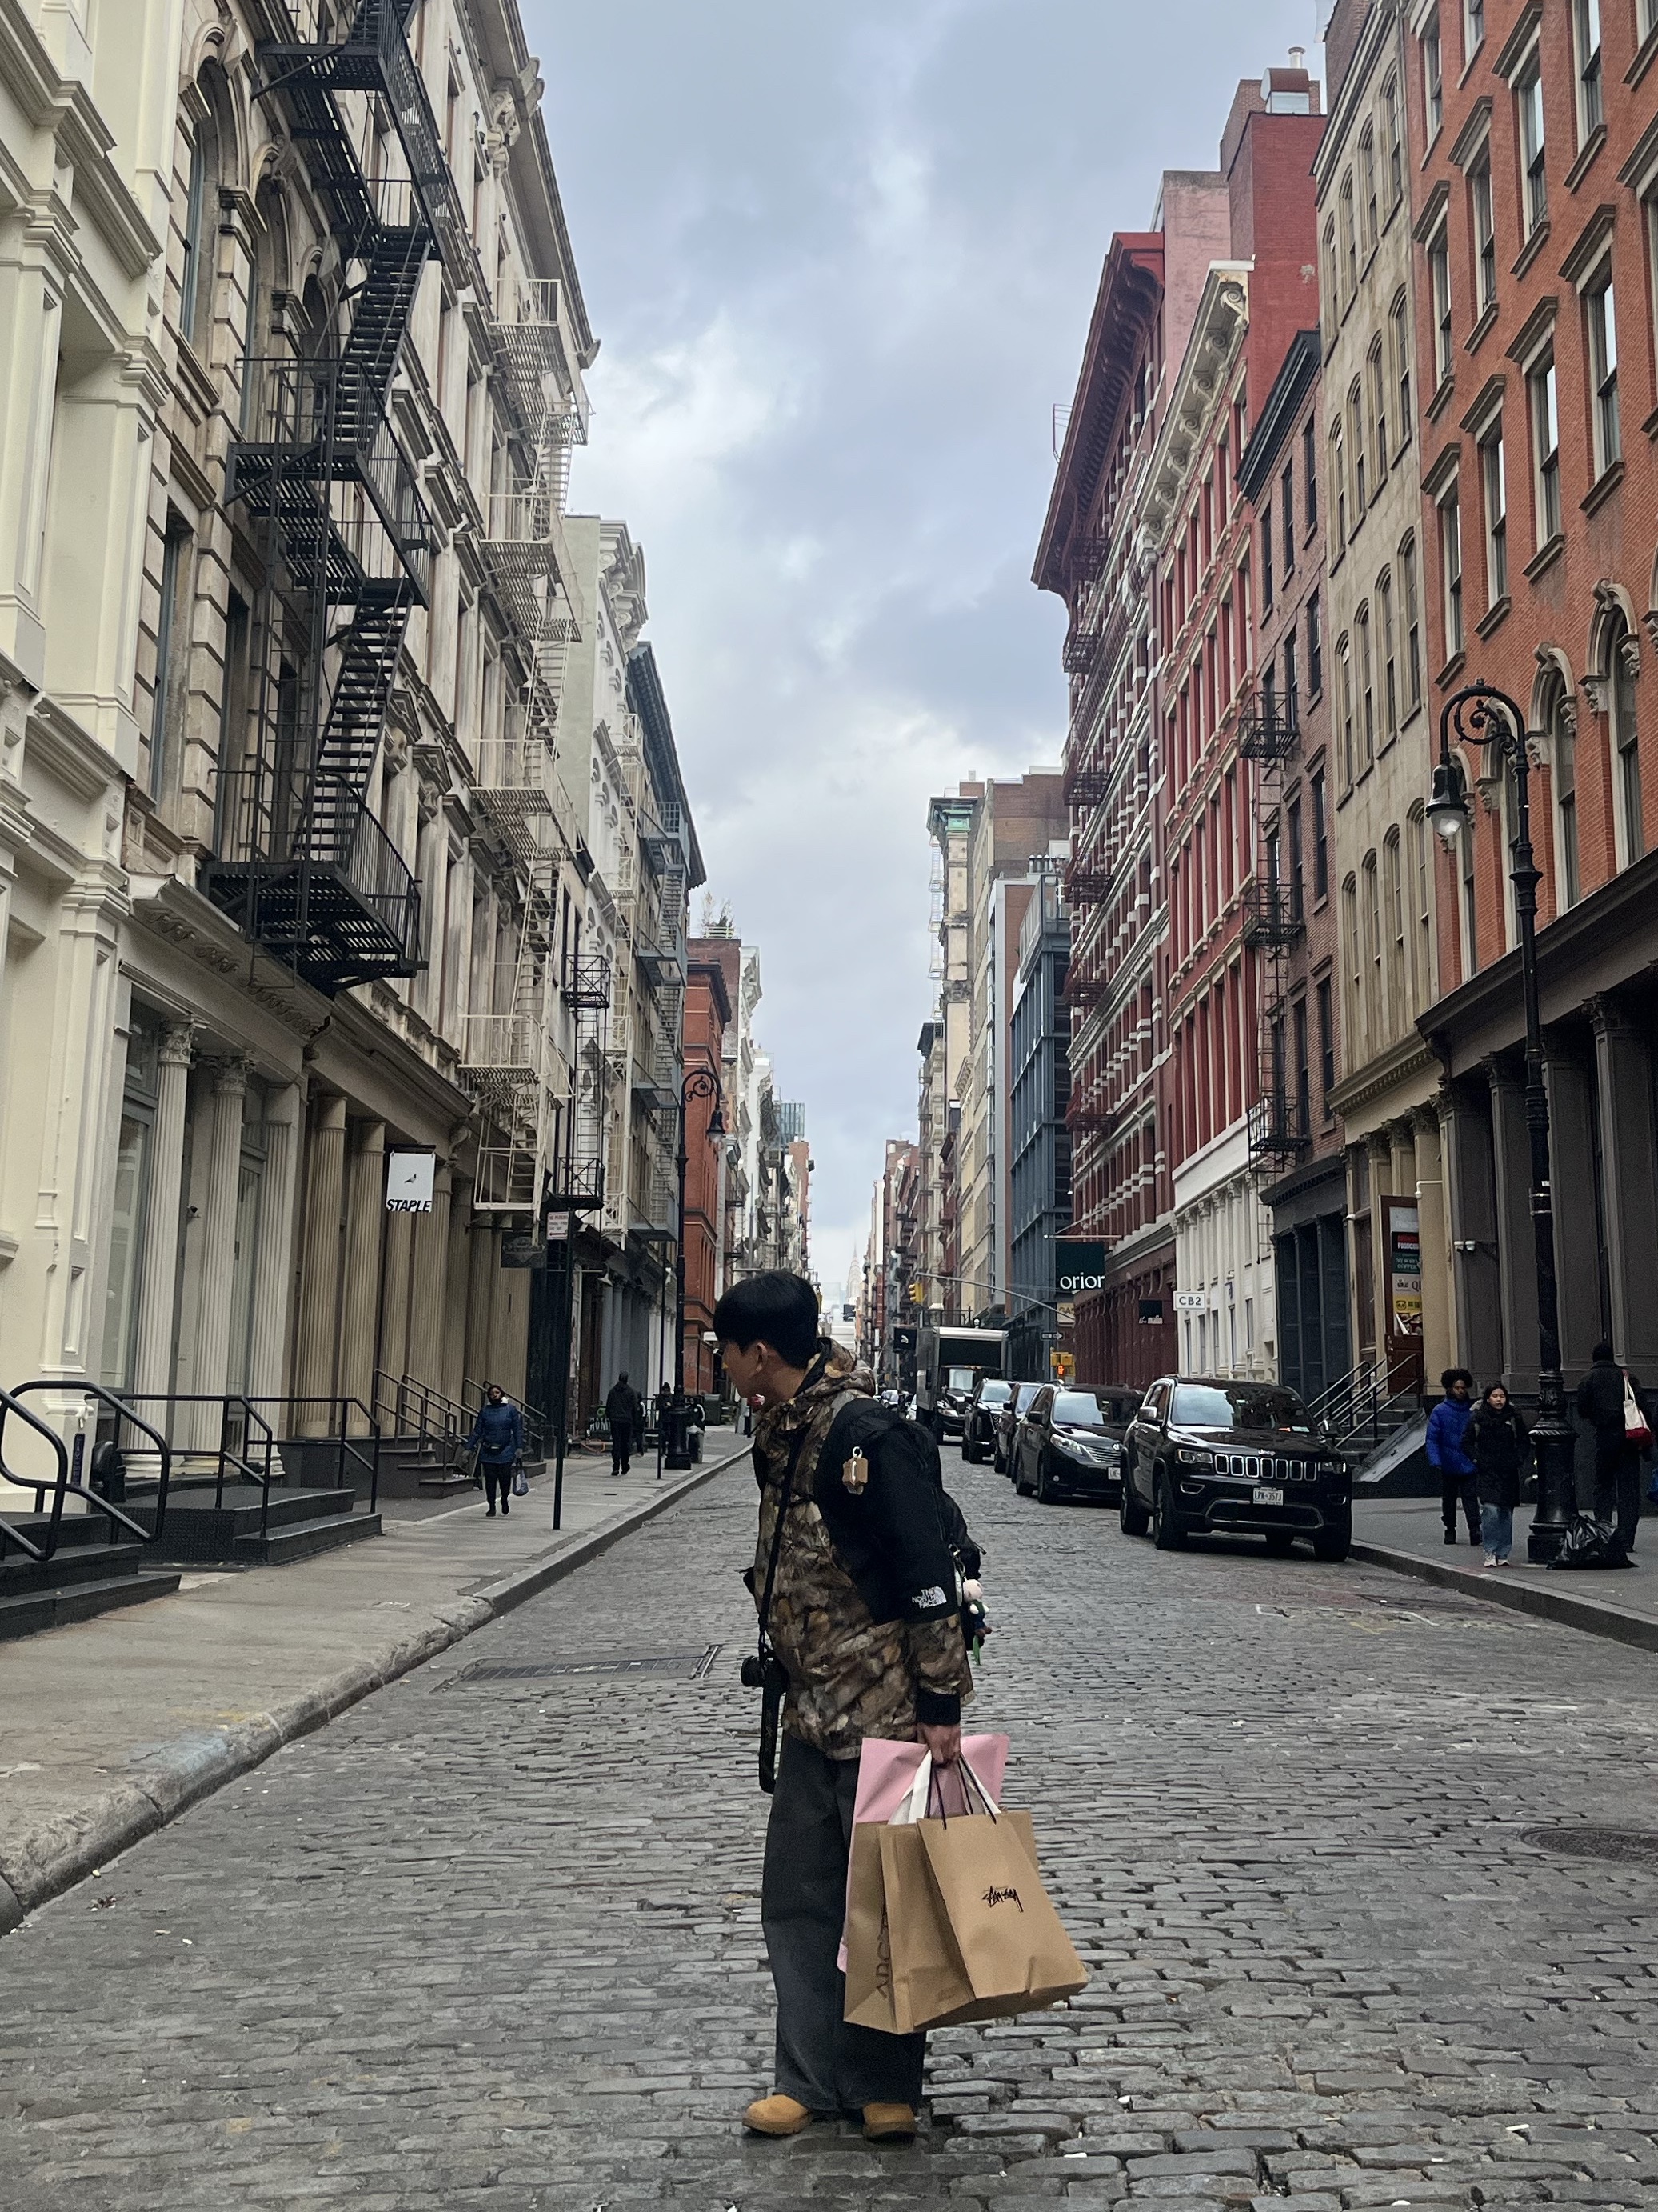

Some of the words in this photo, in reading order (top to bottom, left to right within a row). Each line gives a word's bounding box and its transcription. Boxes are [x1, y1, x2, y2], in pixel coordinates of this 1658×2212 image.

[387, 1199, 432, 1212] STAPLE
[1060, 1272, 1105, 1290] orior
[1179, 1296, 1201, 1306] CB2
[912, 1594, 936, 1603] NORTH
[919, 1600, 937, 1609] FACE
